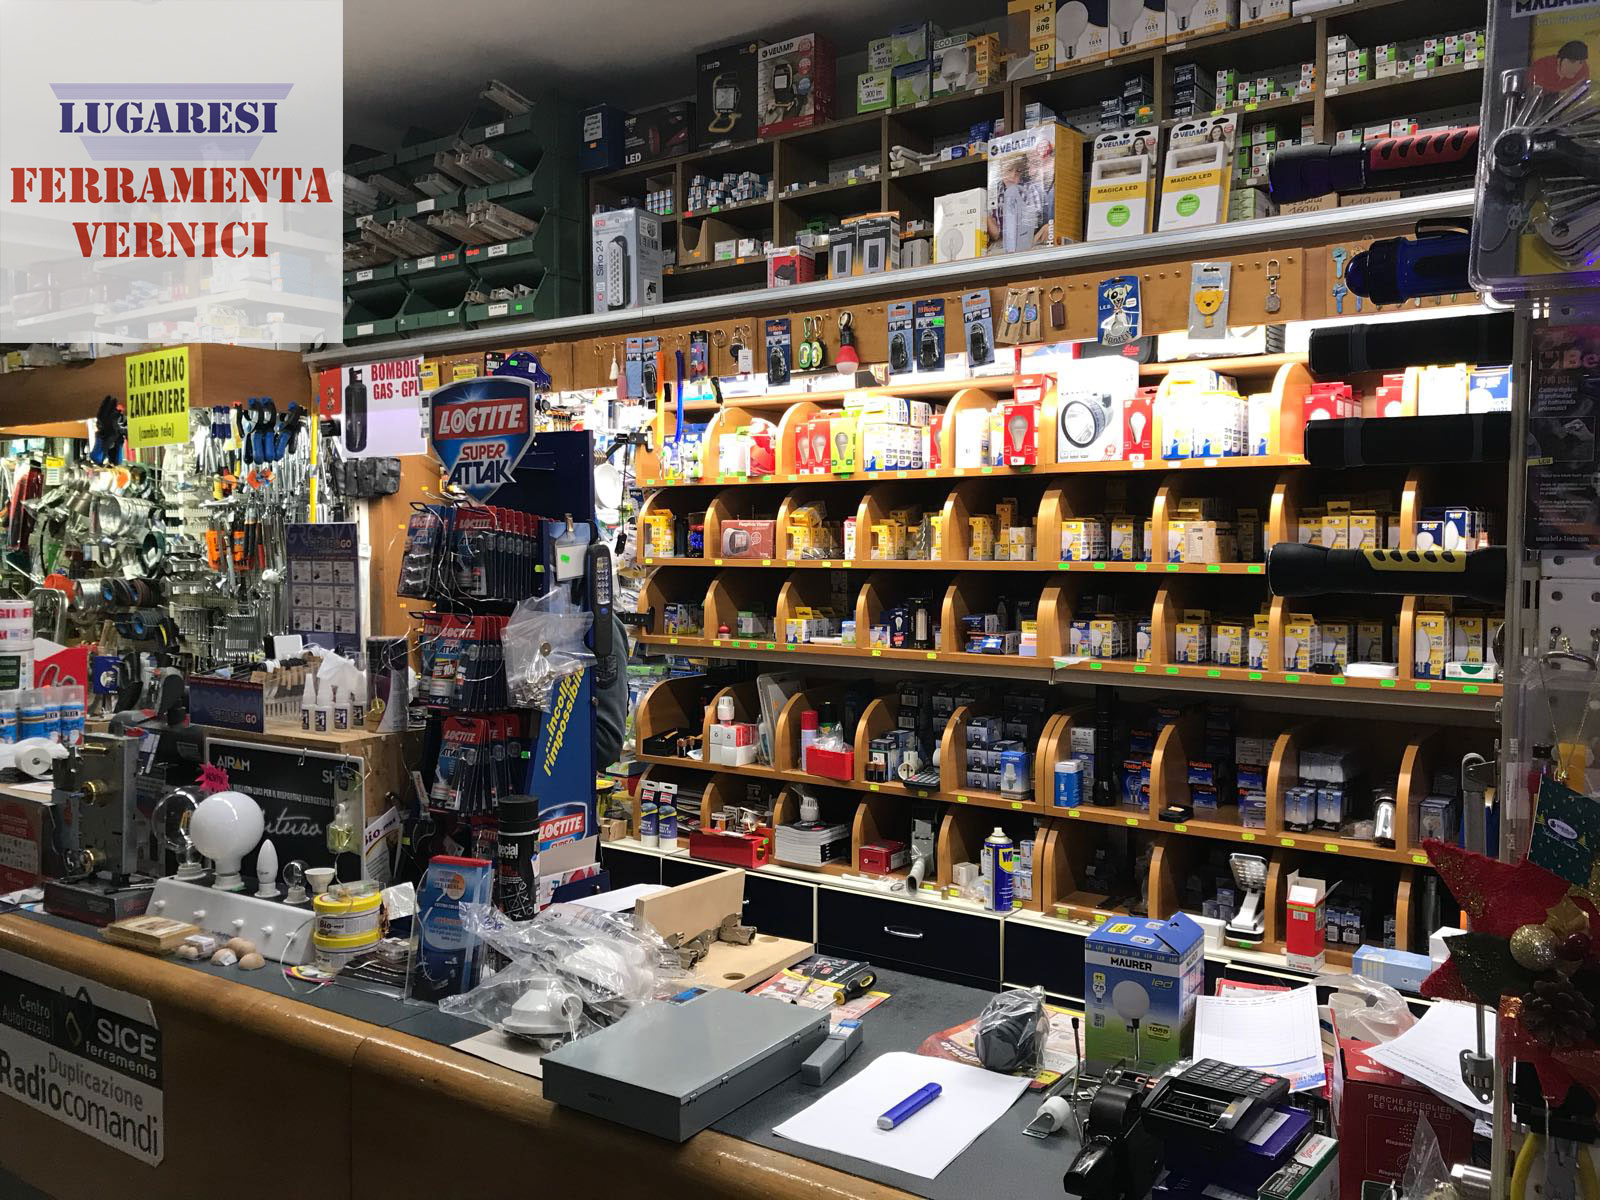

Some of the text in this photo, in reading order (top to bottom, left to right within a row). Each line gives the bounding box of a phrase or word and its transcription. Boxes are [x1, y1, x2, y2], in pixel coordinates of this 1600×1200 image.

[768, 43, 794, 56] VELAMP
[873, 42, 885, 52] LED
[934, 39, 951, 49] ECO
[861, 76, 874, 86] LED
[1180, 128, 1208, 138] VELAMP
[1000, 135, 1036, 153] VELAMP
[1103, 139, 1131, 149] VELAMP
[625, 153, 641, 165] LED
[1170, 172, 1212, 184] MAGICA LED
[1097, 186, 1124, 194] MAGICA
[1046, 219, 1054, 247] Home
[596, 240, 604, 253] 24
[129, 355, 185, 388] SI RIPARANO
[371, 359, 419, 382] BOMBOLE
[373, 380, 393, 400] GAS
[401, 376, 419, 397] GPL
[129, 387, 186, 418] ZANZARIERE
[438, 403, 522, 435] LOCTITE
[459, 443, 505, 461] SUPER
[448, 460, 517, 485] ATTAK
[459, 518, 491, 529] LOCTITE
[441, 627, 476, 638] LOCTITE
[444, 731, 476, 743] LOCTITE
[216, 755, 250, 772] AIRAM
[263, 807, 324, 836] utura
[538, 815, 583, 840] LOCTITE
[498, 842, 518, 857] pecial
[1110, 956, 1153, 972] MAURER
[1151, 977, 1174, 990] led
[19, 993, 50, 1019] Centro
[2, 1005, 50, 1039] Autorizzato
[97, 1018, 157, 1062] SICE
[86, 1040, 157, 1080] ferramenta
[49, 1052, 143, 1112] Duplicazione
[0, 1048, 158, 1157] Radiocomandi
[1373, 1101, 1451, 1121] LE LAMPAE LED
